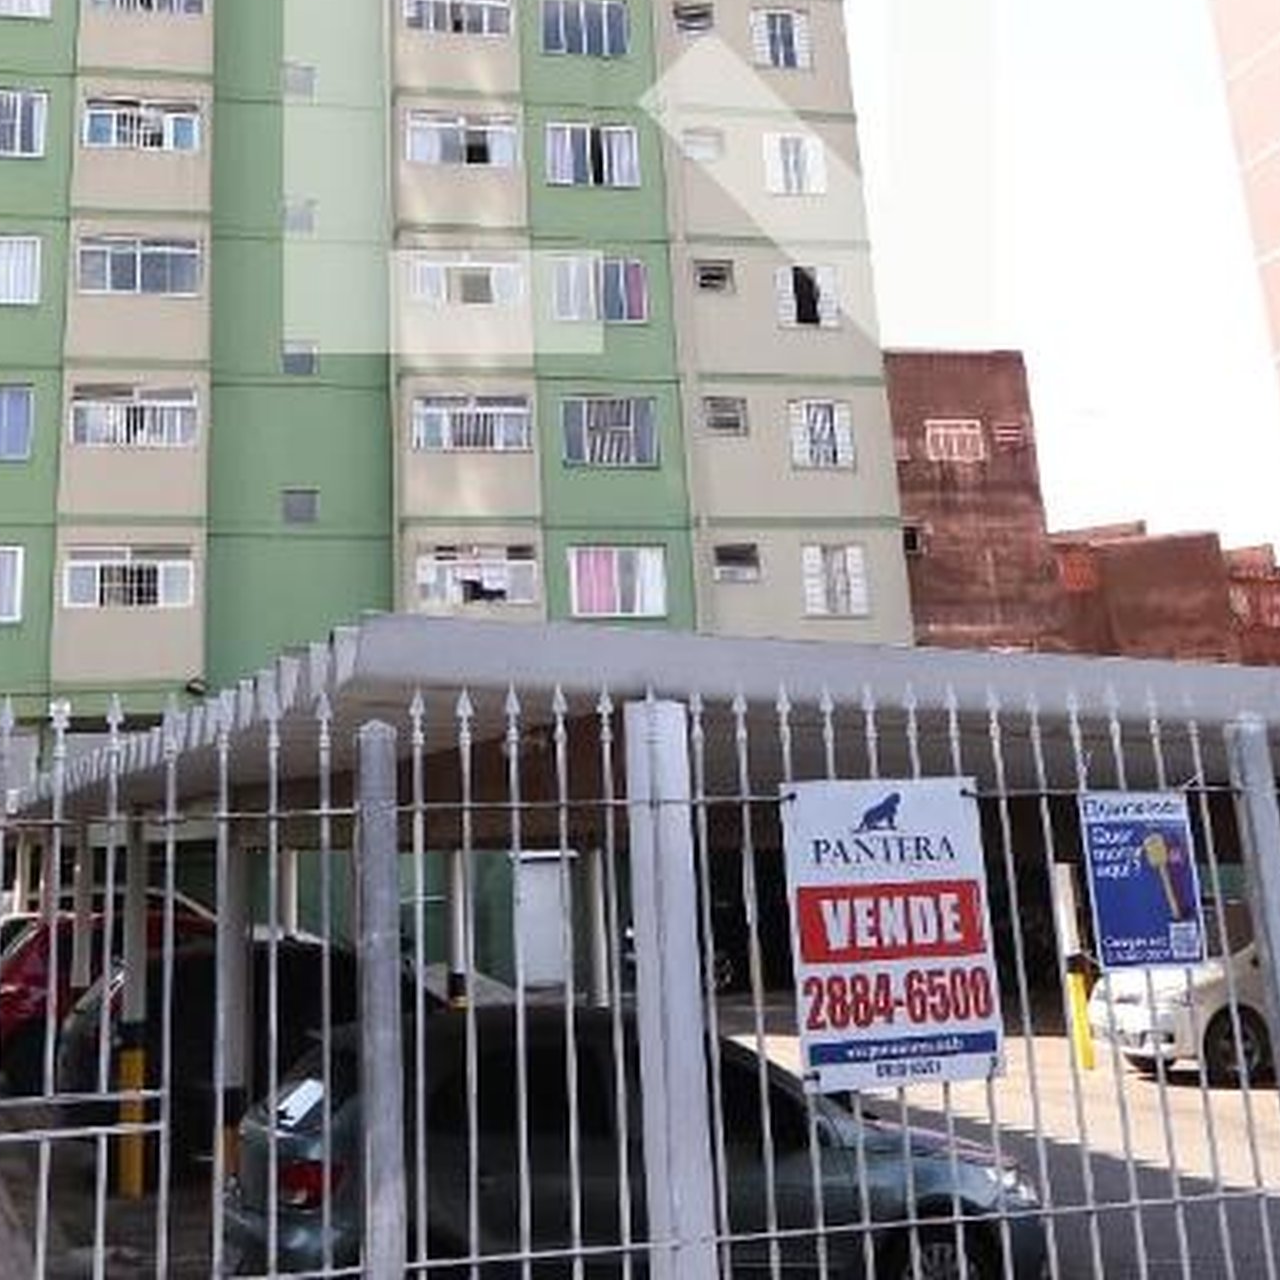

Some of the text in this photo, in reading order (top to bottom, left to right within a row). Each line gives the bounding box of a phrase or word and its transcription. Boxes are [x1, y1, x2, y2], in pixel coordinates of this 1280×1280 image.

[813, 835, 956, 864] PANTERA
[819, 892, 965, 951] VENDE
[803, 967, 995, 1030] 2884-6500
